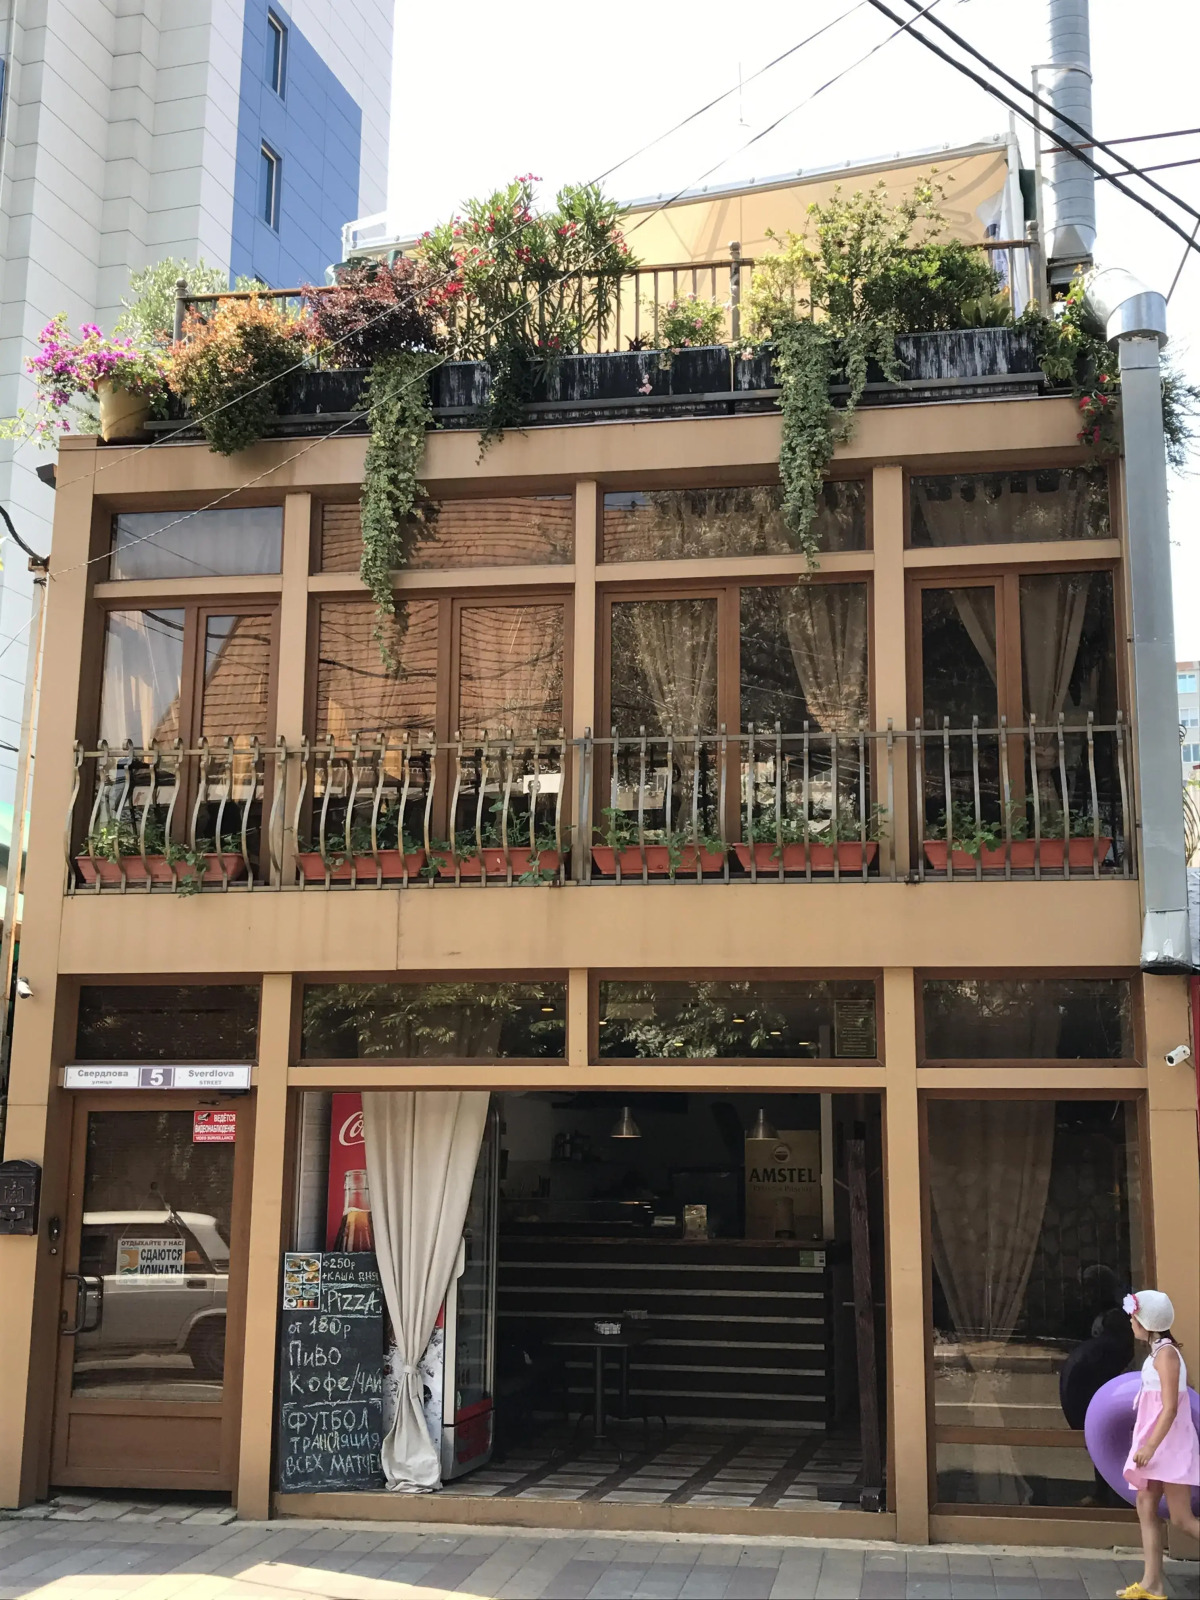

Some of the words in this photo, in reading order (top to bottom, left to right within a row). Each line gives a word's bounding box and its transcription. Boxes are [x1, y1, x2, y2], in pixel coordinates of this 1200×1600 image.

[77, 1069, 129, 1079] Свердлова
[150, 1068, 164, 1086] 5
[188, 1069, 235, 1078] Sverdlova
[748, 1167, 817, 1183] AMSTEL
[140, 1248, 183, 1263] СДАЮТСЯ
[140, 1264, 183, 1277] КОМНАТЫ
[288, 1407, 369, 1435] ФУТБОЛ
[286, 1454, 324, 1476] ВСЕХ
